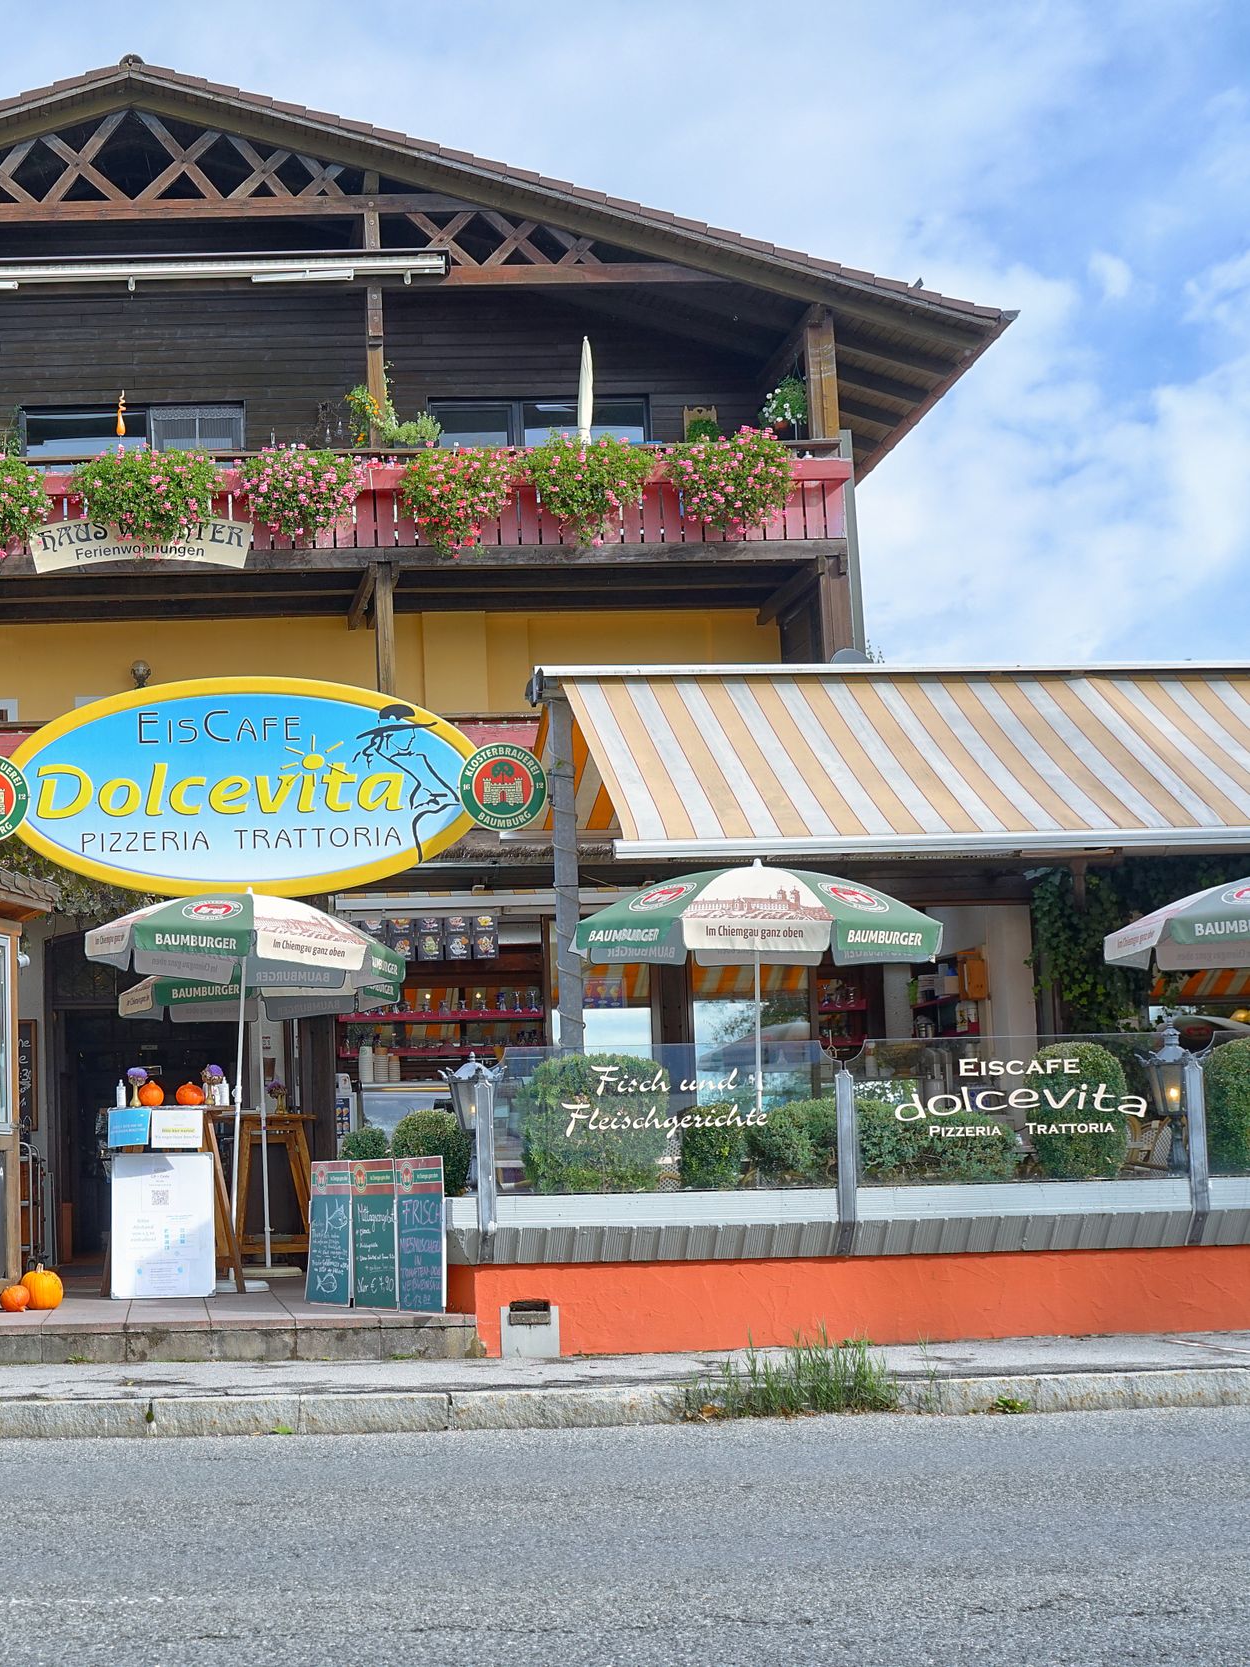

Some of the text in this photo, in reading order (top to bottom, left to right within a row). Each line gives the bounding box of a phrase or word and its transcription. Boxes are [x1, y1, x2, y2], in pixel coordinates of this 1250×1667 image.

[464, 746, 540, 777] KLOSTERBRAUEREI
[35, 762, 405, 820] Dolcevita
[477, 810, 531, 828] BAUMBURG
[80, 826, 402, 853] PIZZERIA TRATTORIA
[588, 928, 660, 942] BAUMBURGER
[705, 925, 804, 940] Im Chiemgau ganz oben
[1194, 919, 1250, 936] BAUMB
[155, 933, 237, 950] BAUMBURGER
[846, 930, 923, 946] BAUMBURGER
[272, 939, 346, 958] Im Chiemgau ganz oben
[172, 984, 240, 999] BAUMBURGER
[591, 1065, 738, 1097] Fisch und
[894, 1083, 1148, 1122] dolcevita
[561, 1103, 769, 1139] Fleischgerichte
[929, 1122, 1116, 1138] PIZZERIA TRATTORIA
[402, 1199, 442, 1225] FRISCH
